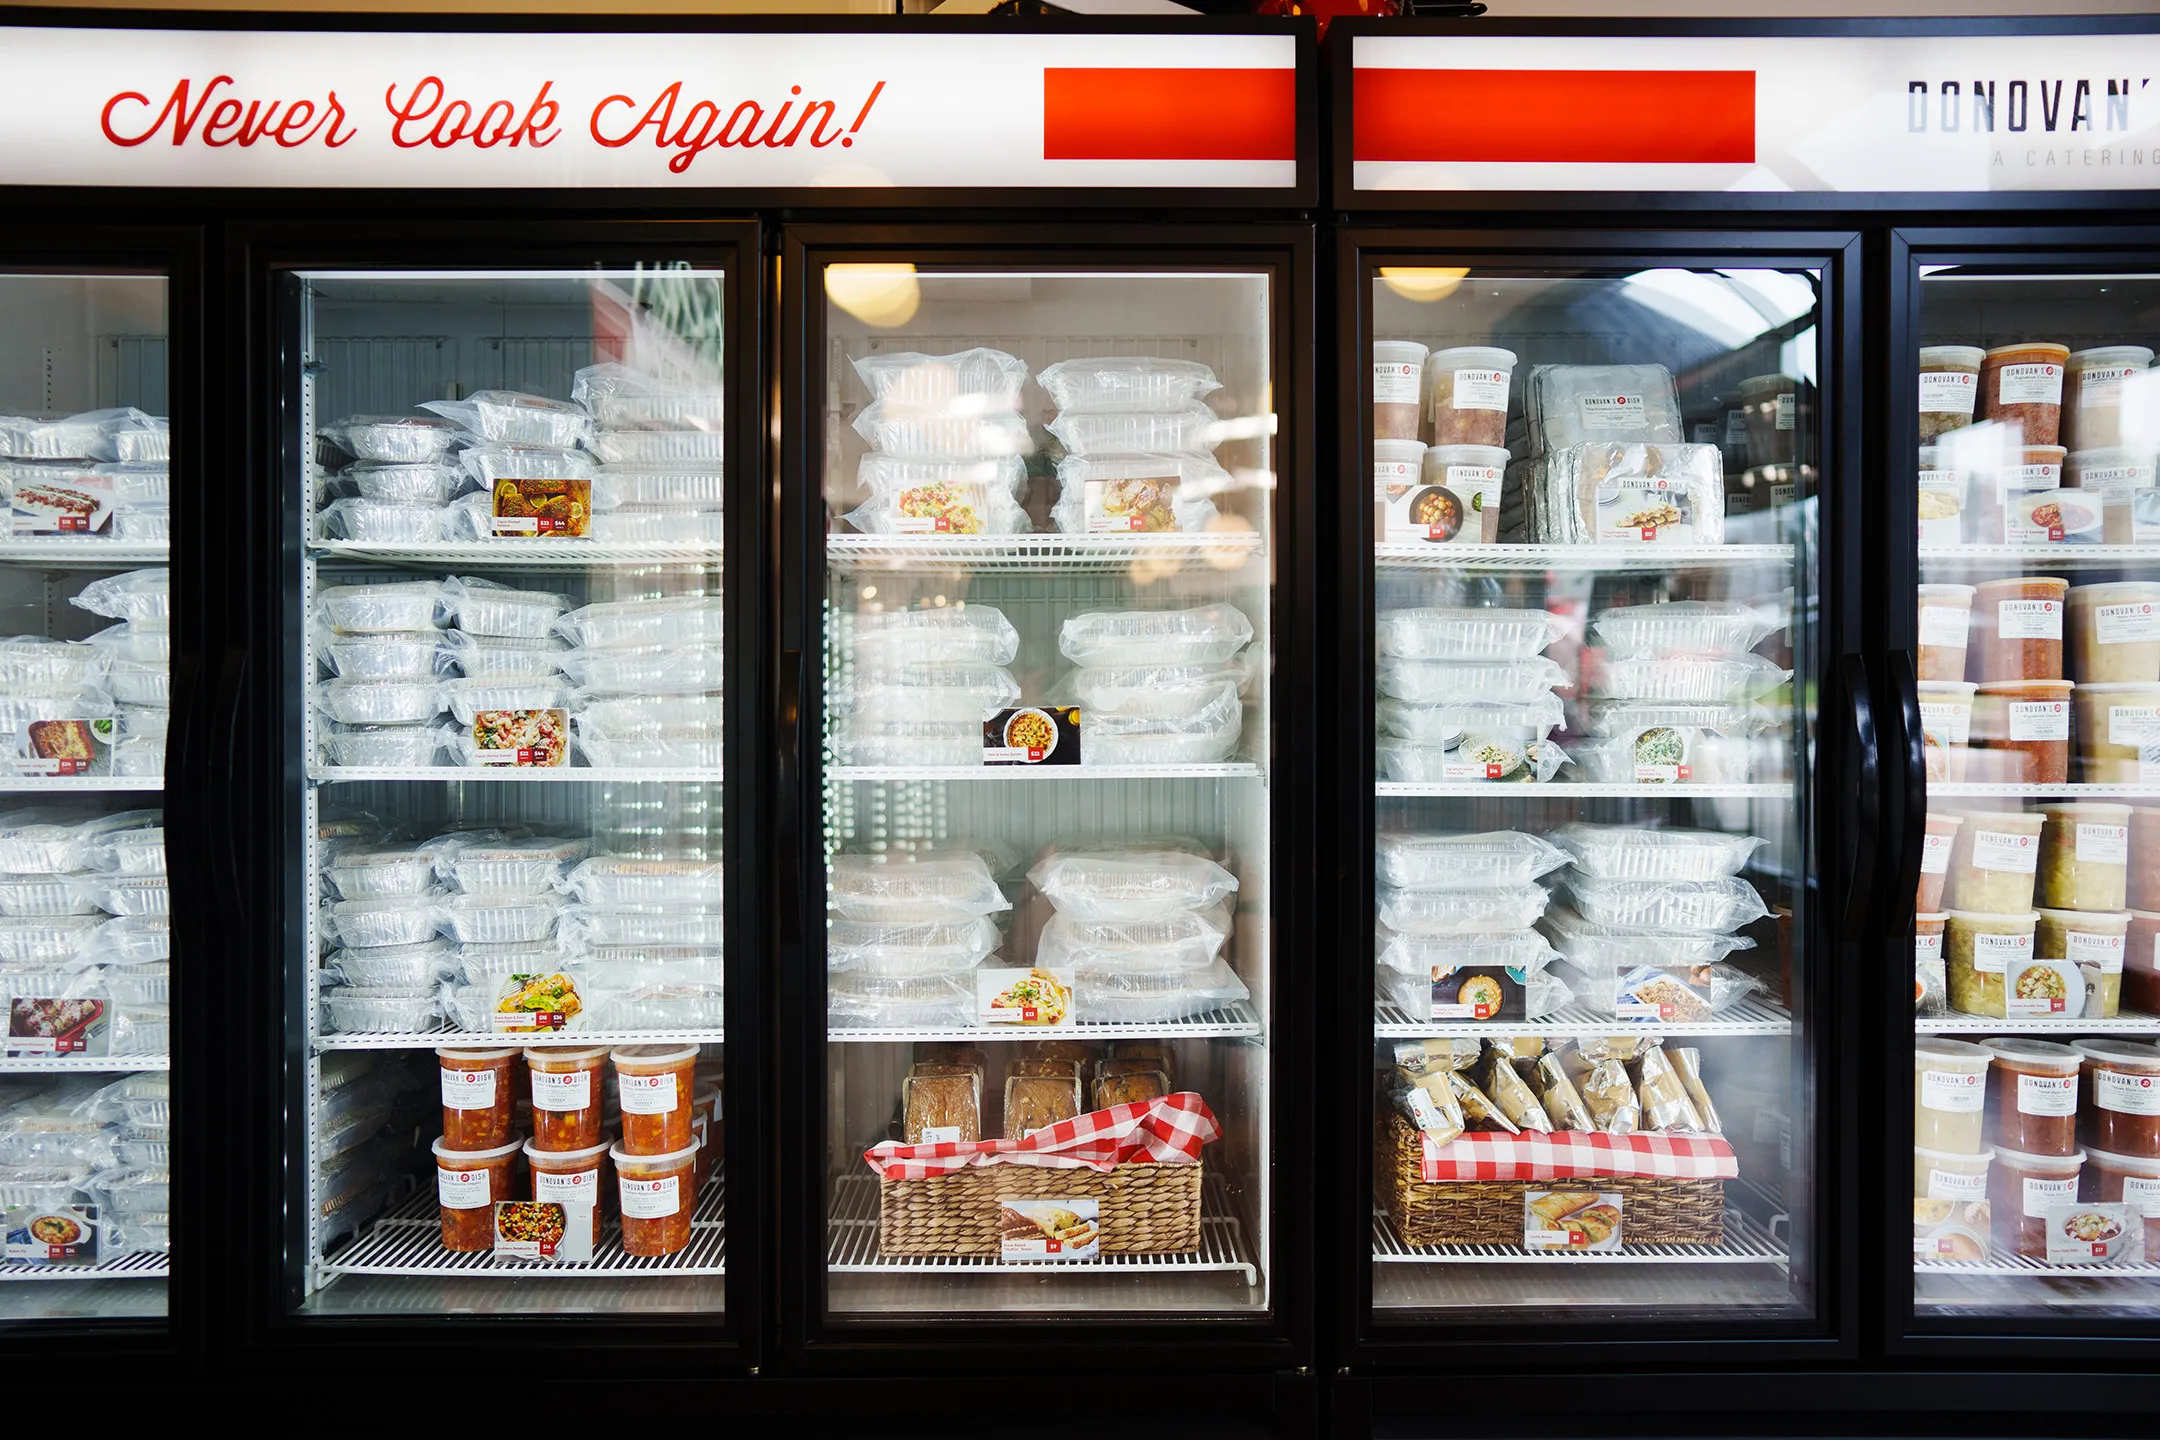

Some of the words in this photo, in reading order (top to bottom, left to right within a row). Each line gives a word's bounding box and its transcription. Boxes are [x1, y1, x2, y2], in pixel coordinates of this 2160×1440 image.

[101, 74, 357, 149] Never
[386, 75, 562, 149] Cook
[589, 80, 886, 174] Again!
[1993, 149, 2004, 166] A
[2027, 149, 2160, 167] CATERING
[2006, 367, 2044, 377] DONOVAN'S
[2082, 370, 2122, 380] DONOVAN'S
[1924, 375, 1961, 384] DONOVAN'S
[2085, 469, 2125, 480] DONOVAN'S
[1622, 480, 1656, 489] DONOVAN'S
[2004, 603, 2042, 611] DONOVAN'S
[2100, 606, 2141, 617] DONOVAN'S
[2015, 705, 2053, 713] DONOVAN'S
[2114, 709, 2154, 717] DONOVAN'S
[1980, 834, 2018, 846] DONOVAN'S
[1980, 937, 2018, 946] DONOVAN'S
[2073, 935, 2111, 946] DONOVAN'S
[477, 1073, 492, 1082] DISH
[573, 1073, 587, 1083] DISH
[1928, 1073, 1966, 1085] DONOVAN'S
[2097, 1073, 2138, 1086] DONOVAN'S
[2024, 1078, 2062, 1089] DONOVAN'S
[471, 1172, 486, 1182] DISH
[539, 1176, 571, 1186] DONOVAN'S
[582, 1173, 596, 1183] DISH
[622, 1181, 651, 1191] DONOVAN'S
[663, 1179, 677, 1189] DISH
[2029, 1182, 2066, 1191] DONOVAN'S
